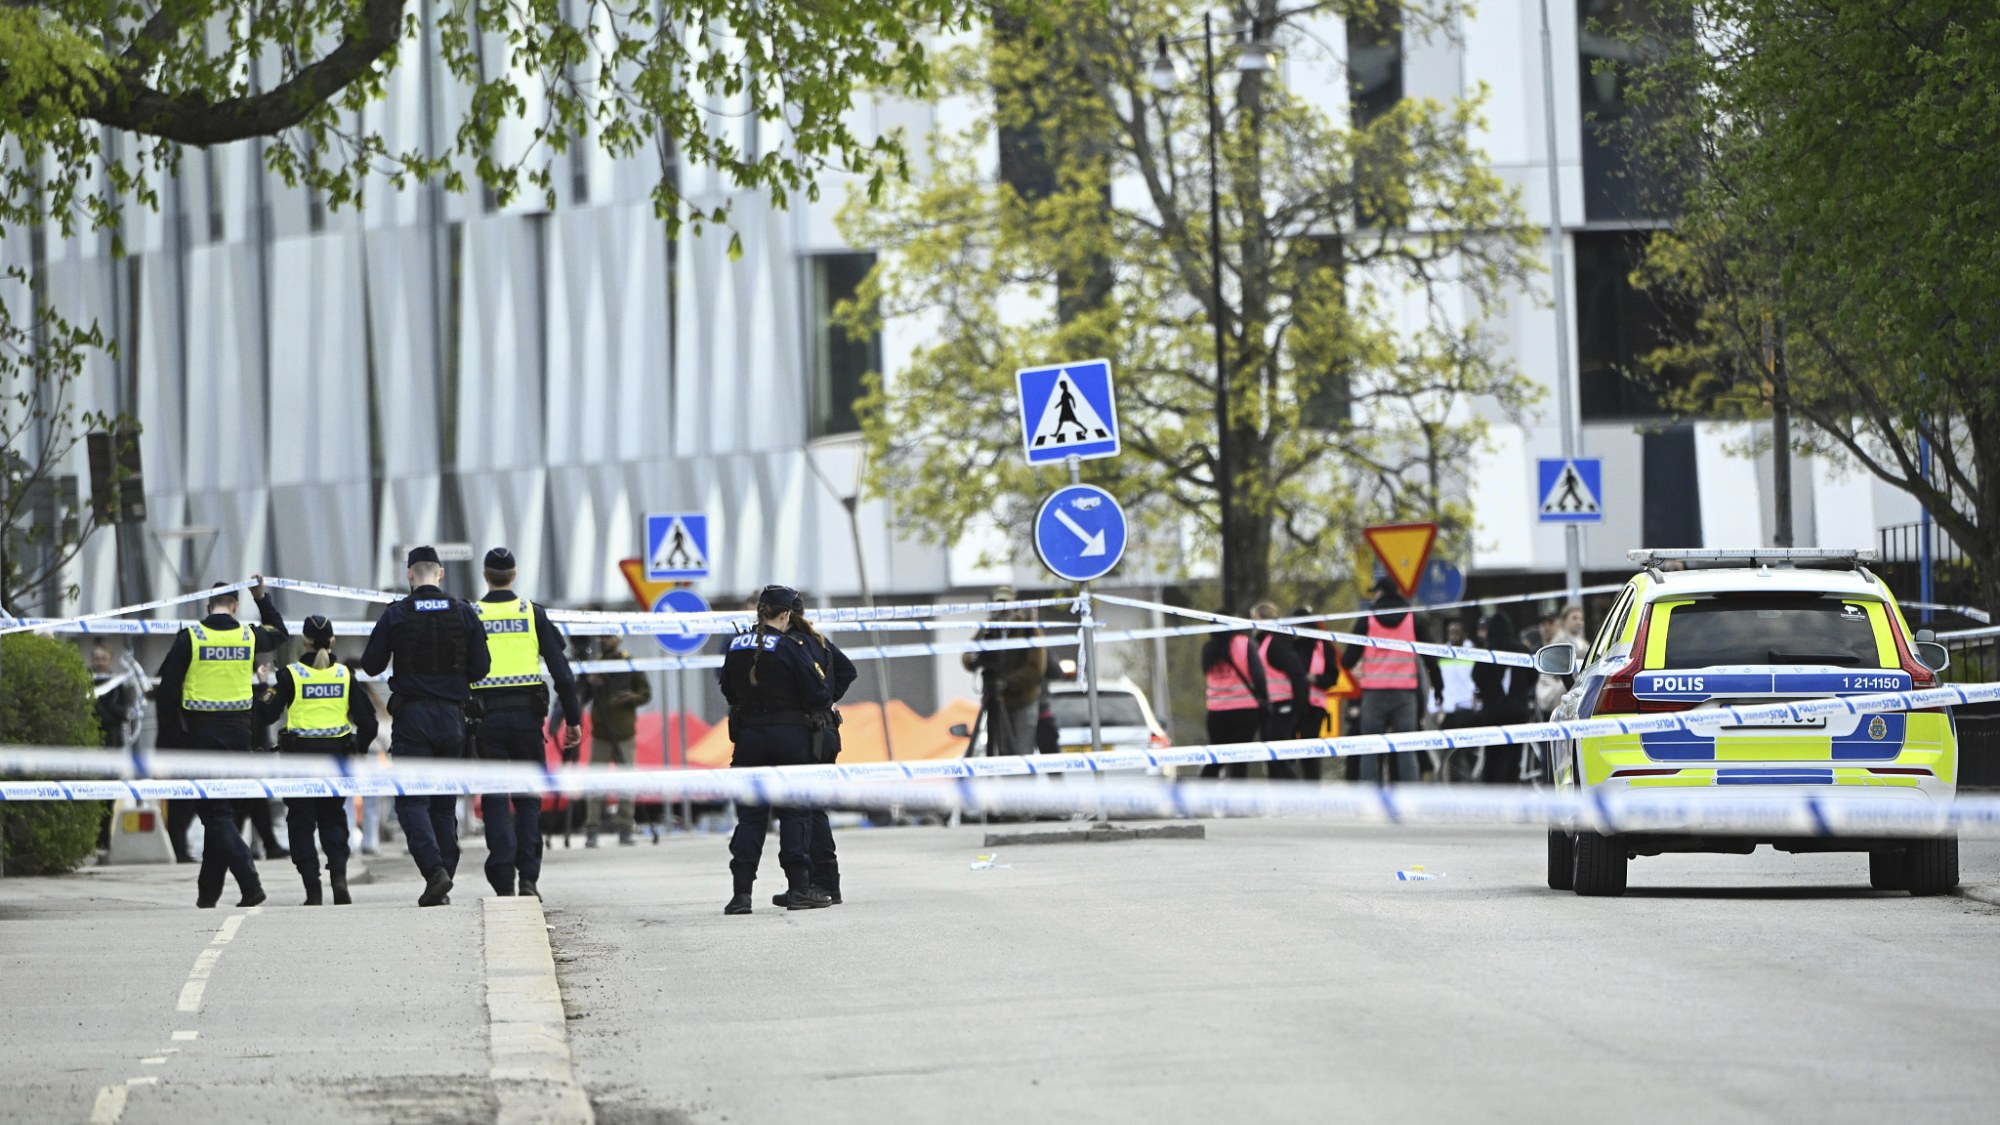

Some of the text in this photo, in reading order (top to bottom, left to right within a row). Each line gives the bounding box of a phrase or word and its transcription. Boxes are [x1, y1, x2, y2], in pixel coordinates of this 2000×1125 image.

[416, 601, 449, 610] POLIS
[483, 619, 524, 633] POLIS
[205, 646, 246, 660] POLIS
[1653, 677, 1704, 691] POLIS
[1842, 677, 1900, 689] 1 21-1150
[305, 685, 342, 697] POLIS
